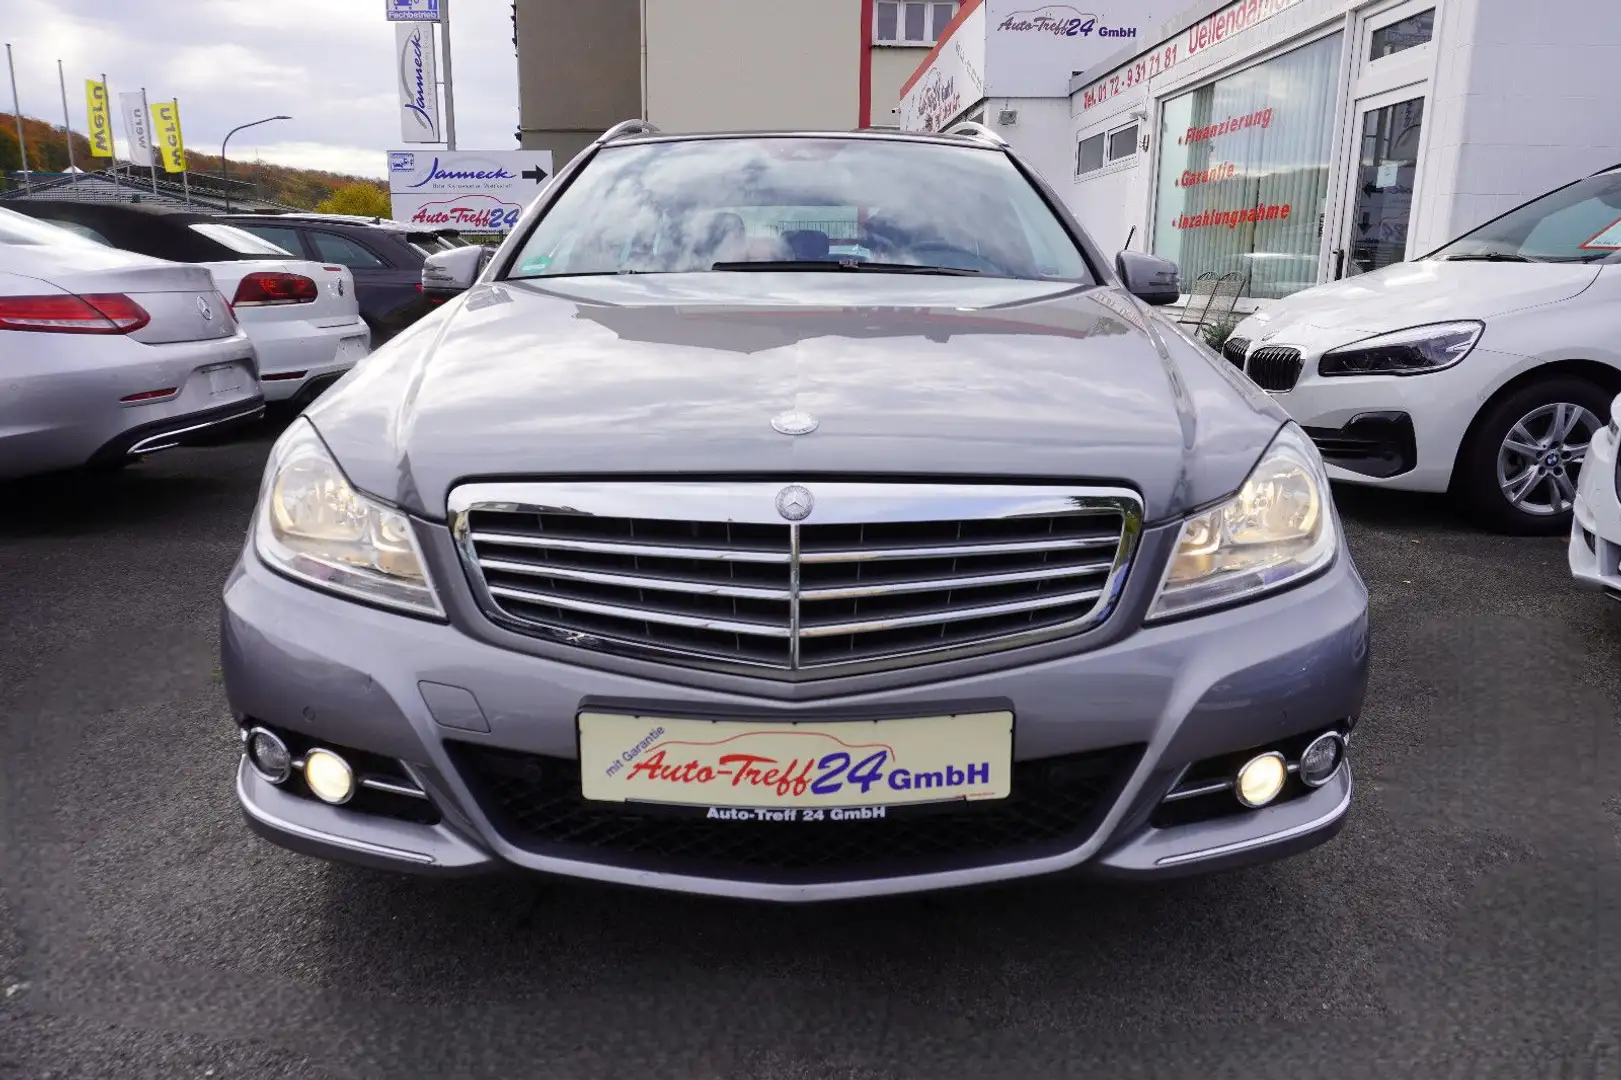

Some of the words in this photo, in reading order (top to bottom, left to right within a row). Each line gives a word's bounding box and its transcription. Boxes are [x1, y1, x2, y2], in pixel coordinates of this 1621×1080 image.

[1098, 26, 1137, 38] GmbH
[405, 30, 434, 137] Janneck
[1083, 88, 1096, 110] Tel.
[1185, 107, 1273, 145] Finanzierung
[406, 157, 517, 187] Janneck
[1181, 161, 1235, 187] Garantie
[606, 759, 624, 777] mit
[622, 726, 666, 761] Garantie
[888, 763, 990, 791] GmbH
[706, 805, 797, 821] Auto-Treff
[801, 806, 826, 821] 24
[830, 805, 887, 821] GmbH
